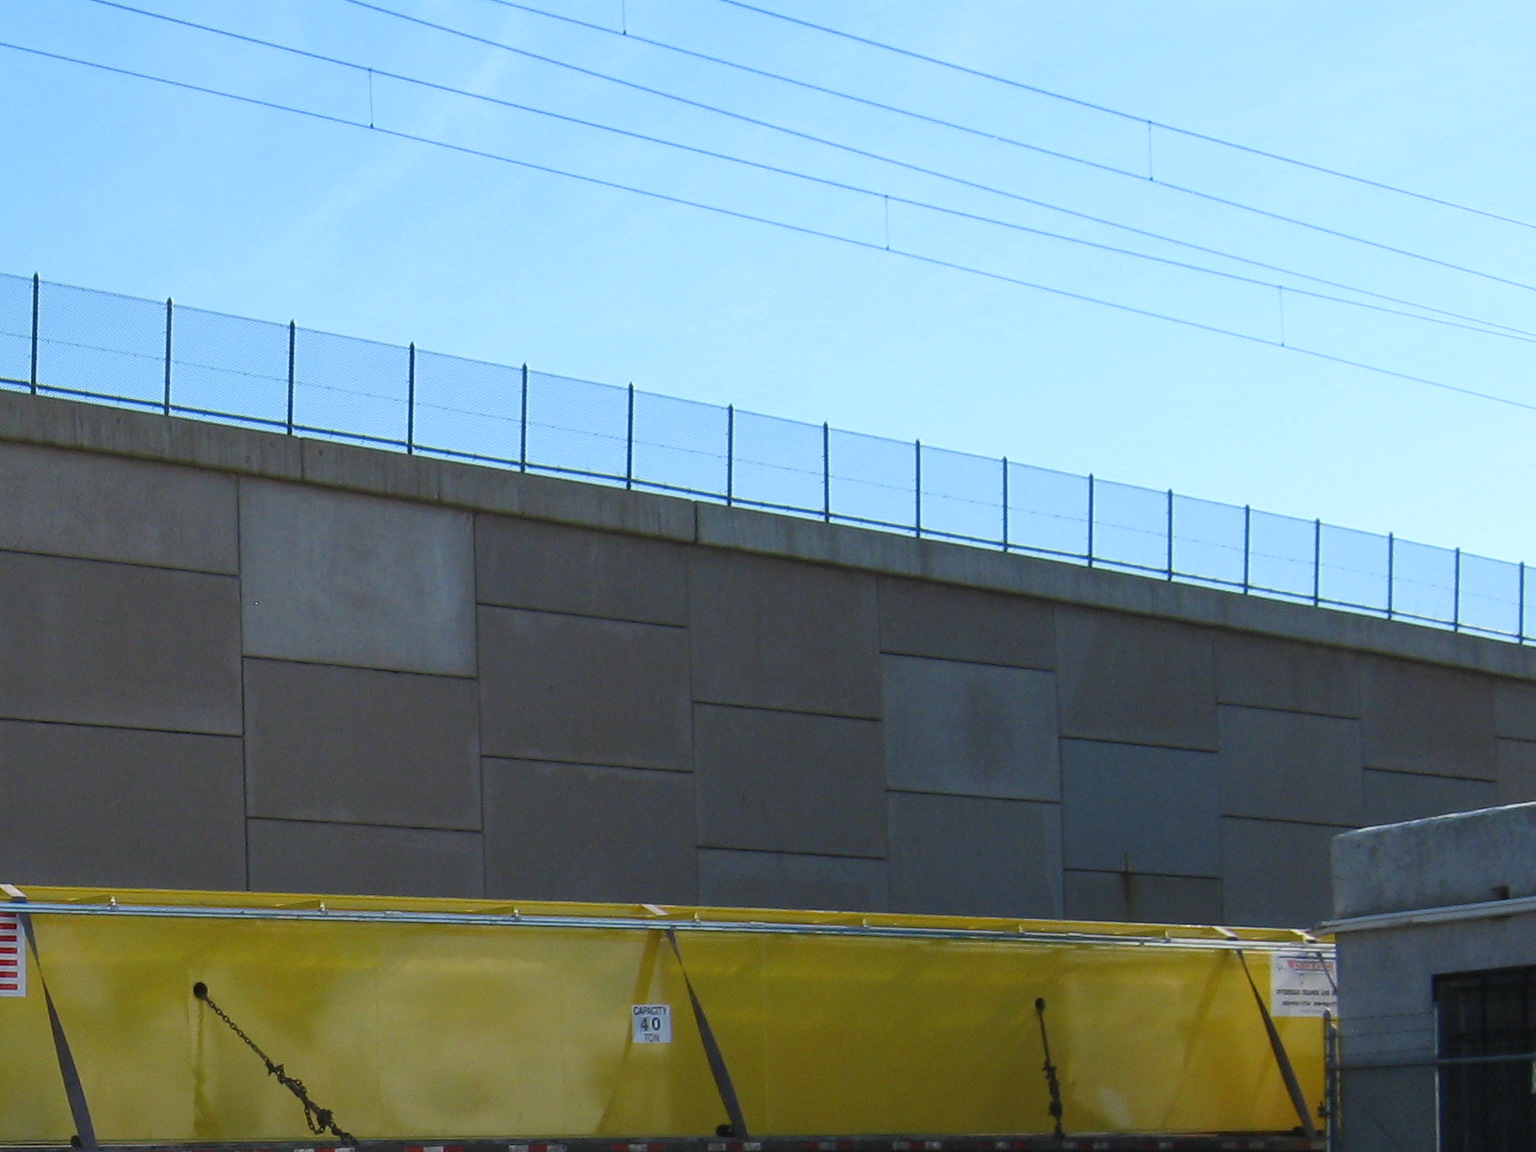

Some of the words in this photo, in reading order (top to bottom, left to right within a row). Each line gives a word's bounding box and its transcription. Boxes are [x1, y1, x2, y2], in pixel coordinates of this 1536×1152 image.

[633, 1006, 667, 1016] CAPACITY
[640, 1017, 661, 1031] 40
[644, 1032, 660, 1042] TON
